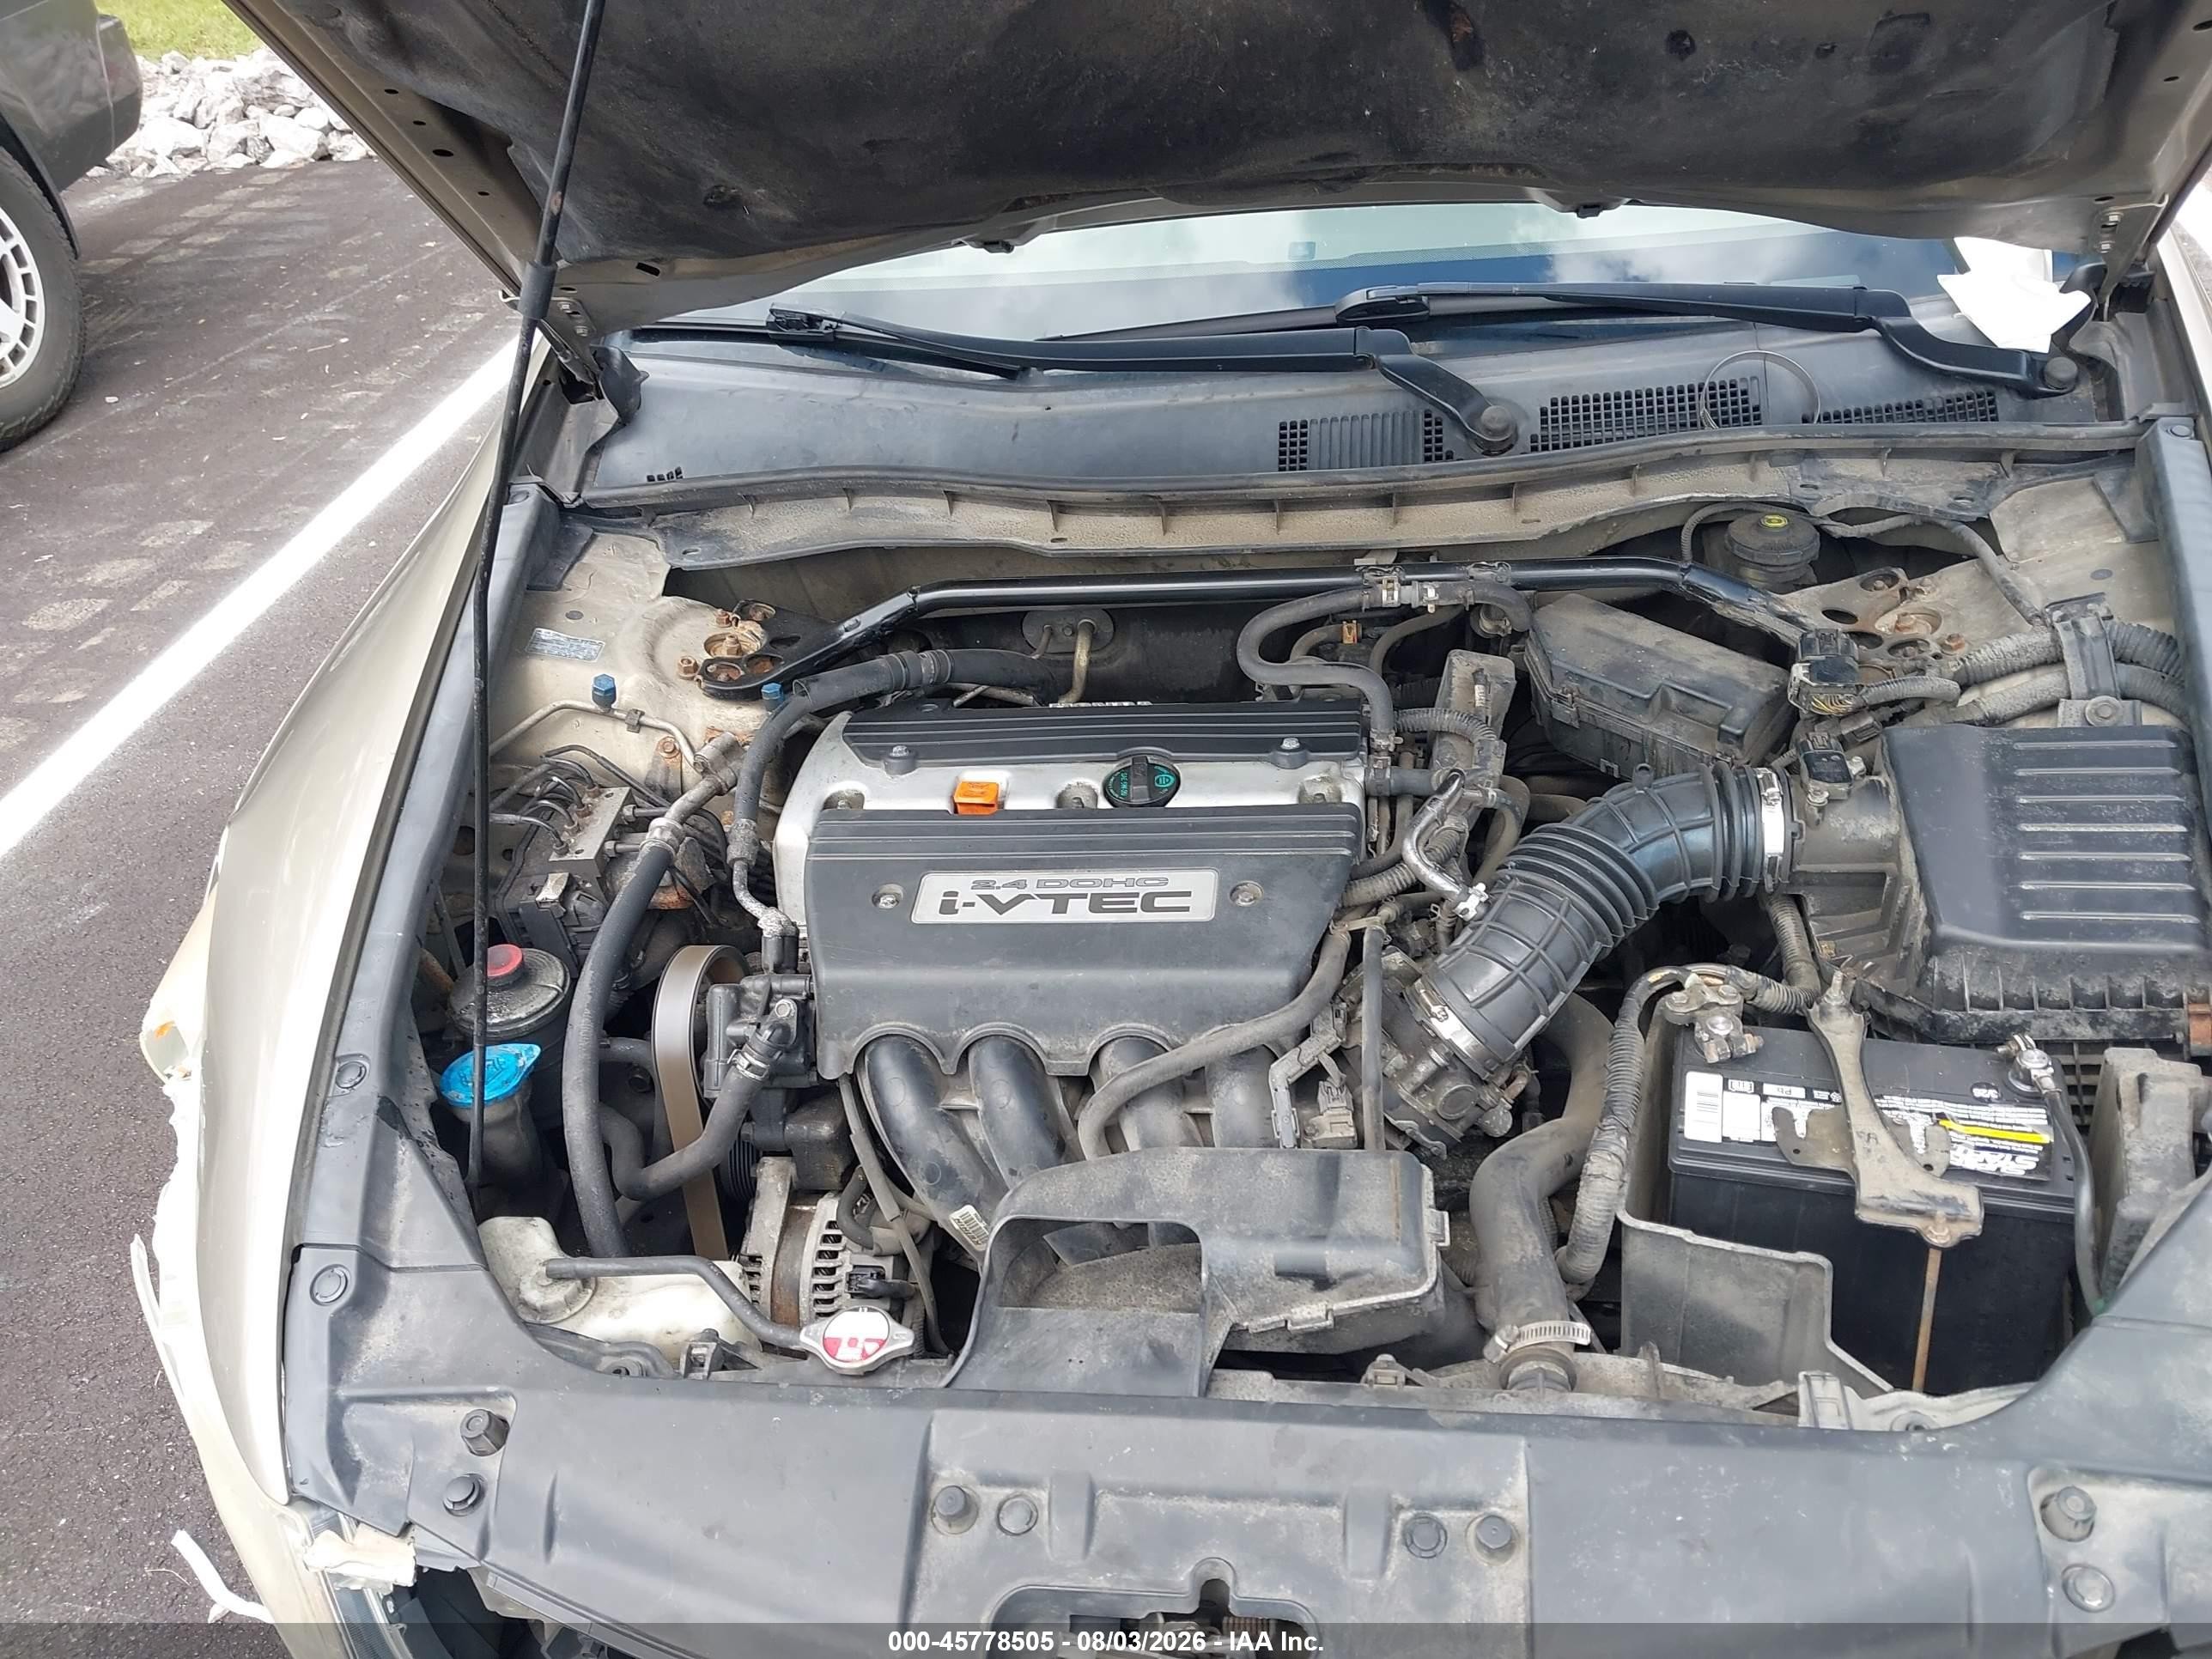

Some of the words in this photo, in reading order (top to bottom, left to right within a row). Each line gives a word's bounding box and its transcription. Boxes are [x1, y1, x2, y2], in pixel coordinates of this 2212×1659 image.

[971, 879, 1027, 890] 2.4
[1036, 878, 1169, 889] DOHC
[939, 890, 1192, 915] i-VTEC
[1777, 1087, 1792, 1096] Pb
